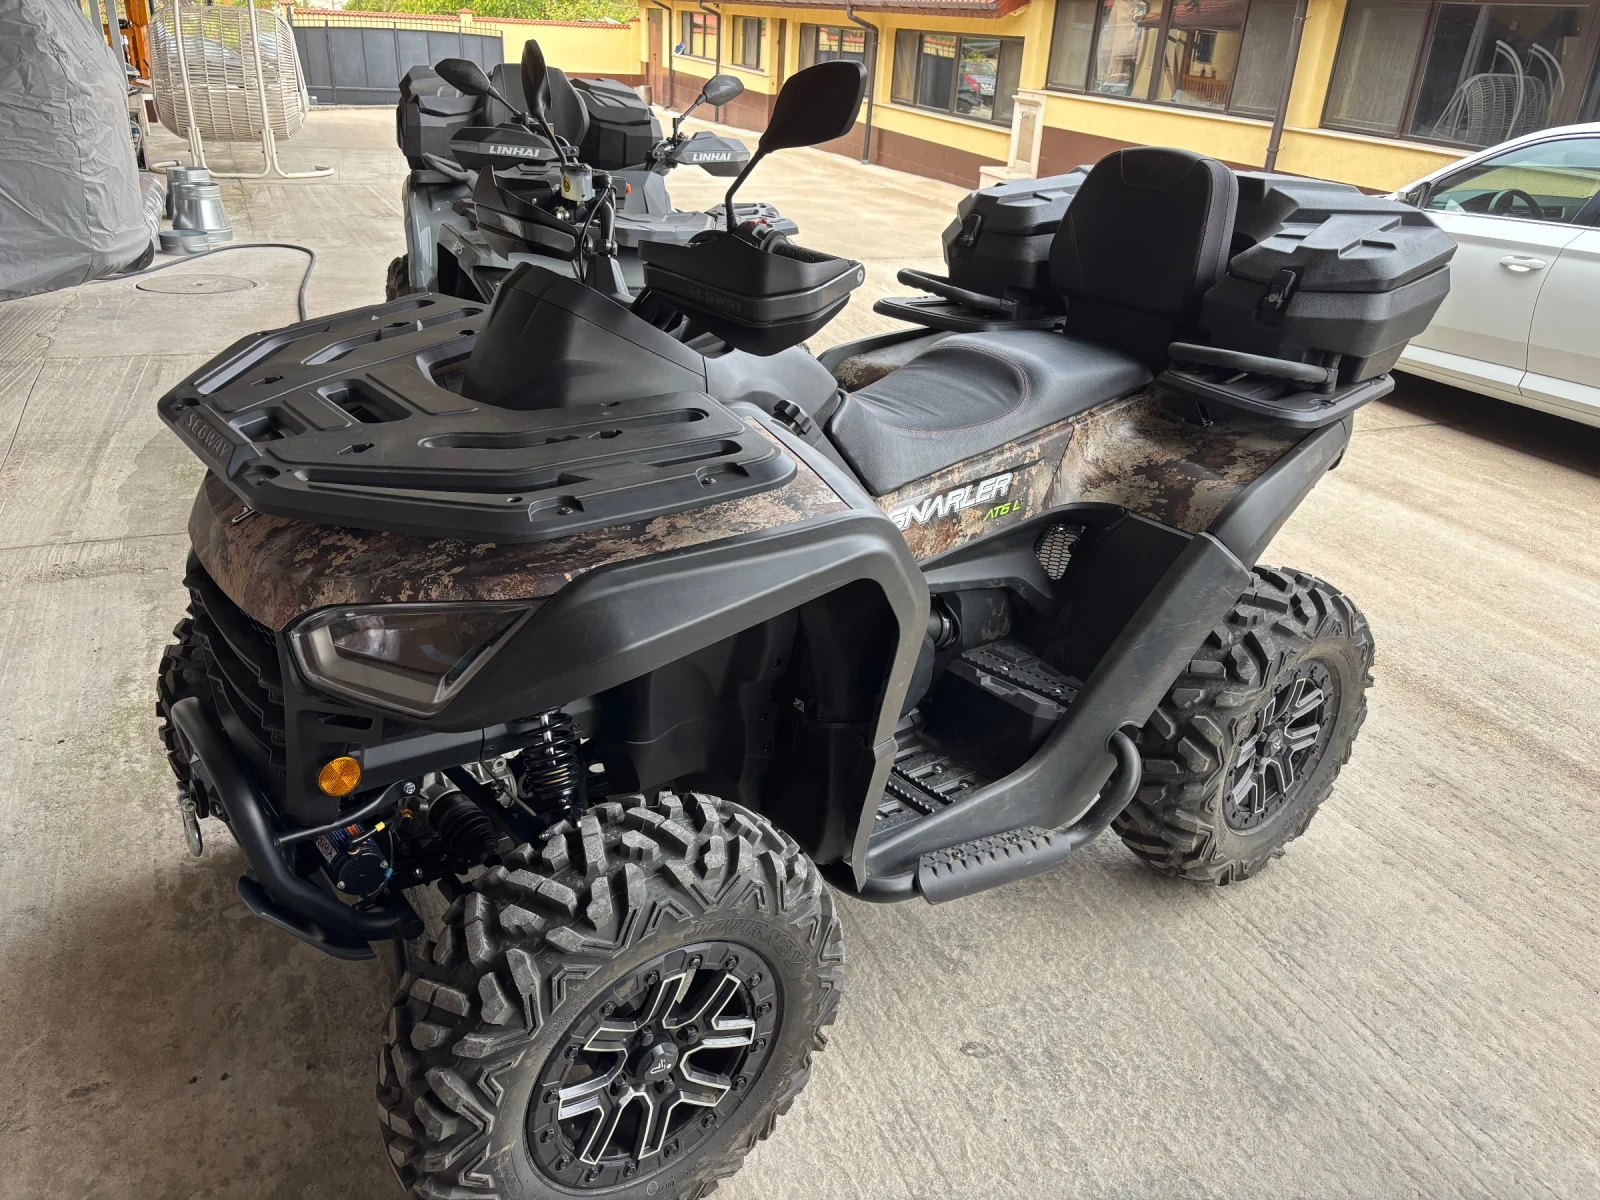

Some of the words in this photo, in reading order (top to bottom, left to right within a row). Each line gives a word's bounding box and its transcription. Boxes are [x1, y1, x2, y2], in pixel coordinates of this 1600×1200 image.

[489, 145, 541, 158] LINHAI
[693, 153, 732, 163] LINHAI
[690, 286, 742, 312] SEGWAY
[185, 413, 230, 457] SEGWAY
[889, 472, 1013, 531] SNARLER
[984, 503, 1011, 521] AT6
[1013, 500, 1021, 511] L
[684, 919, 810, 967] JOURNEY
